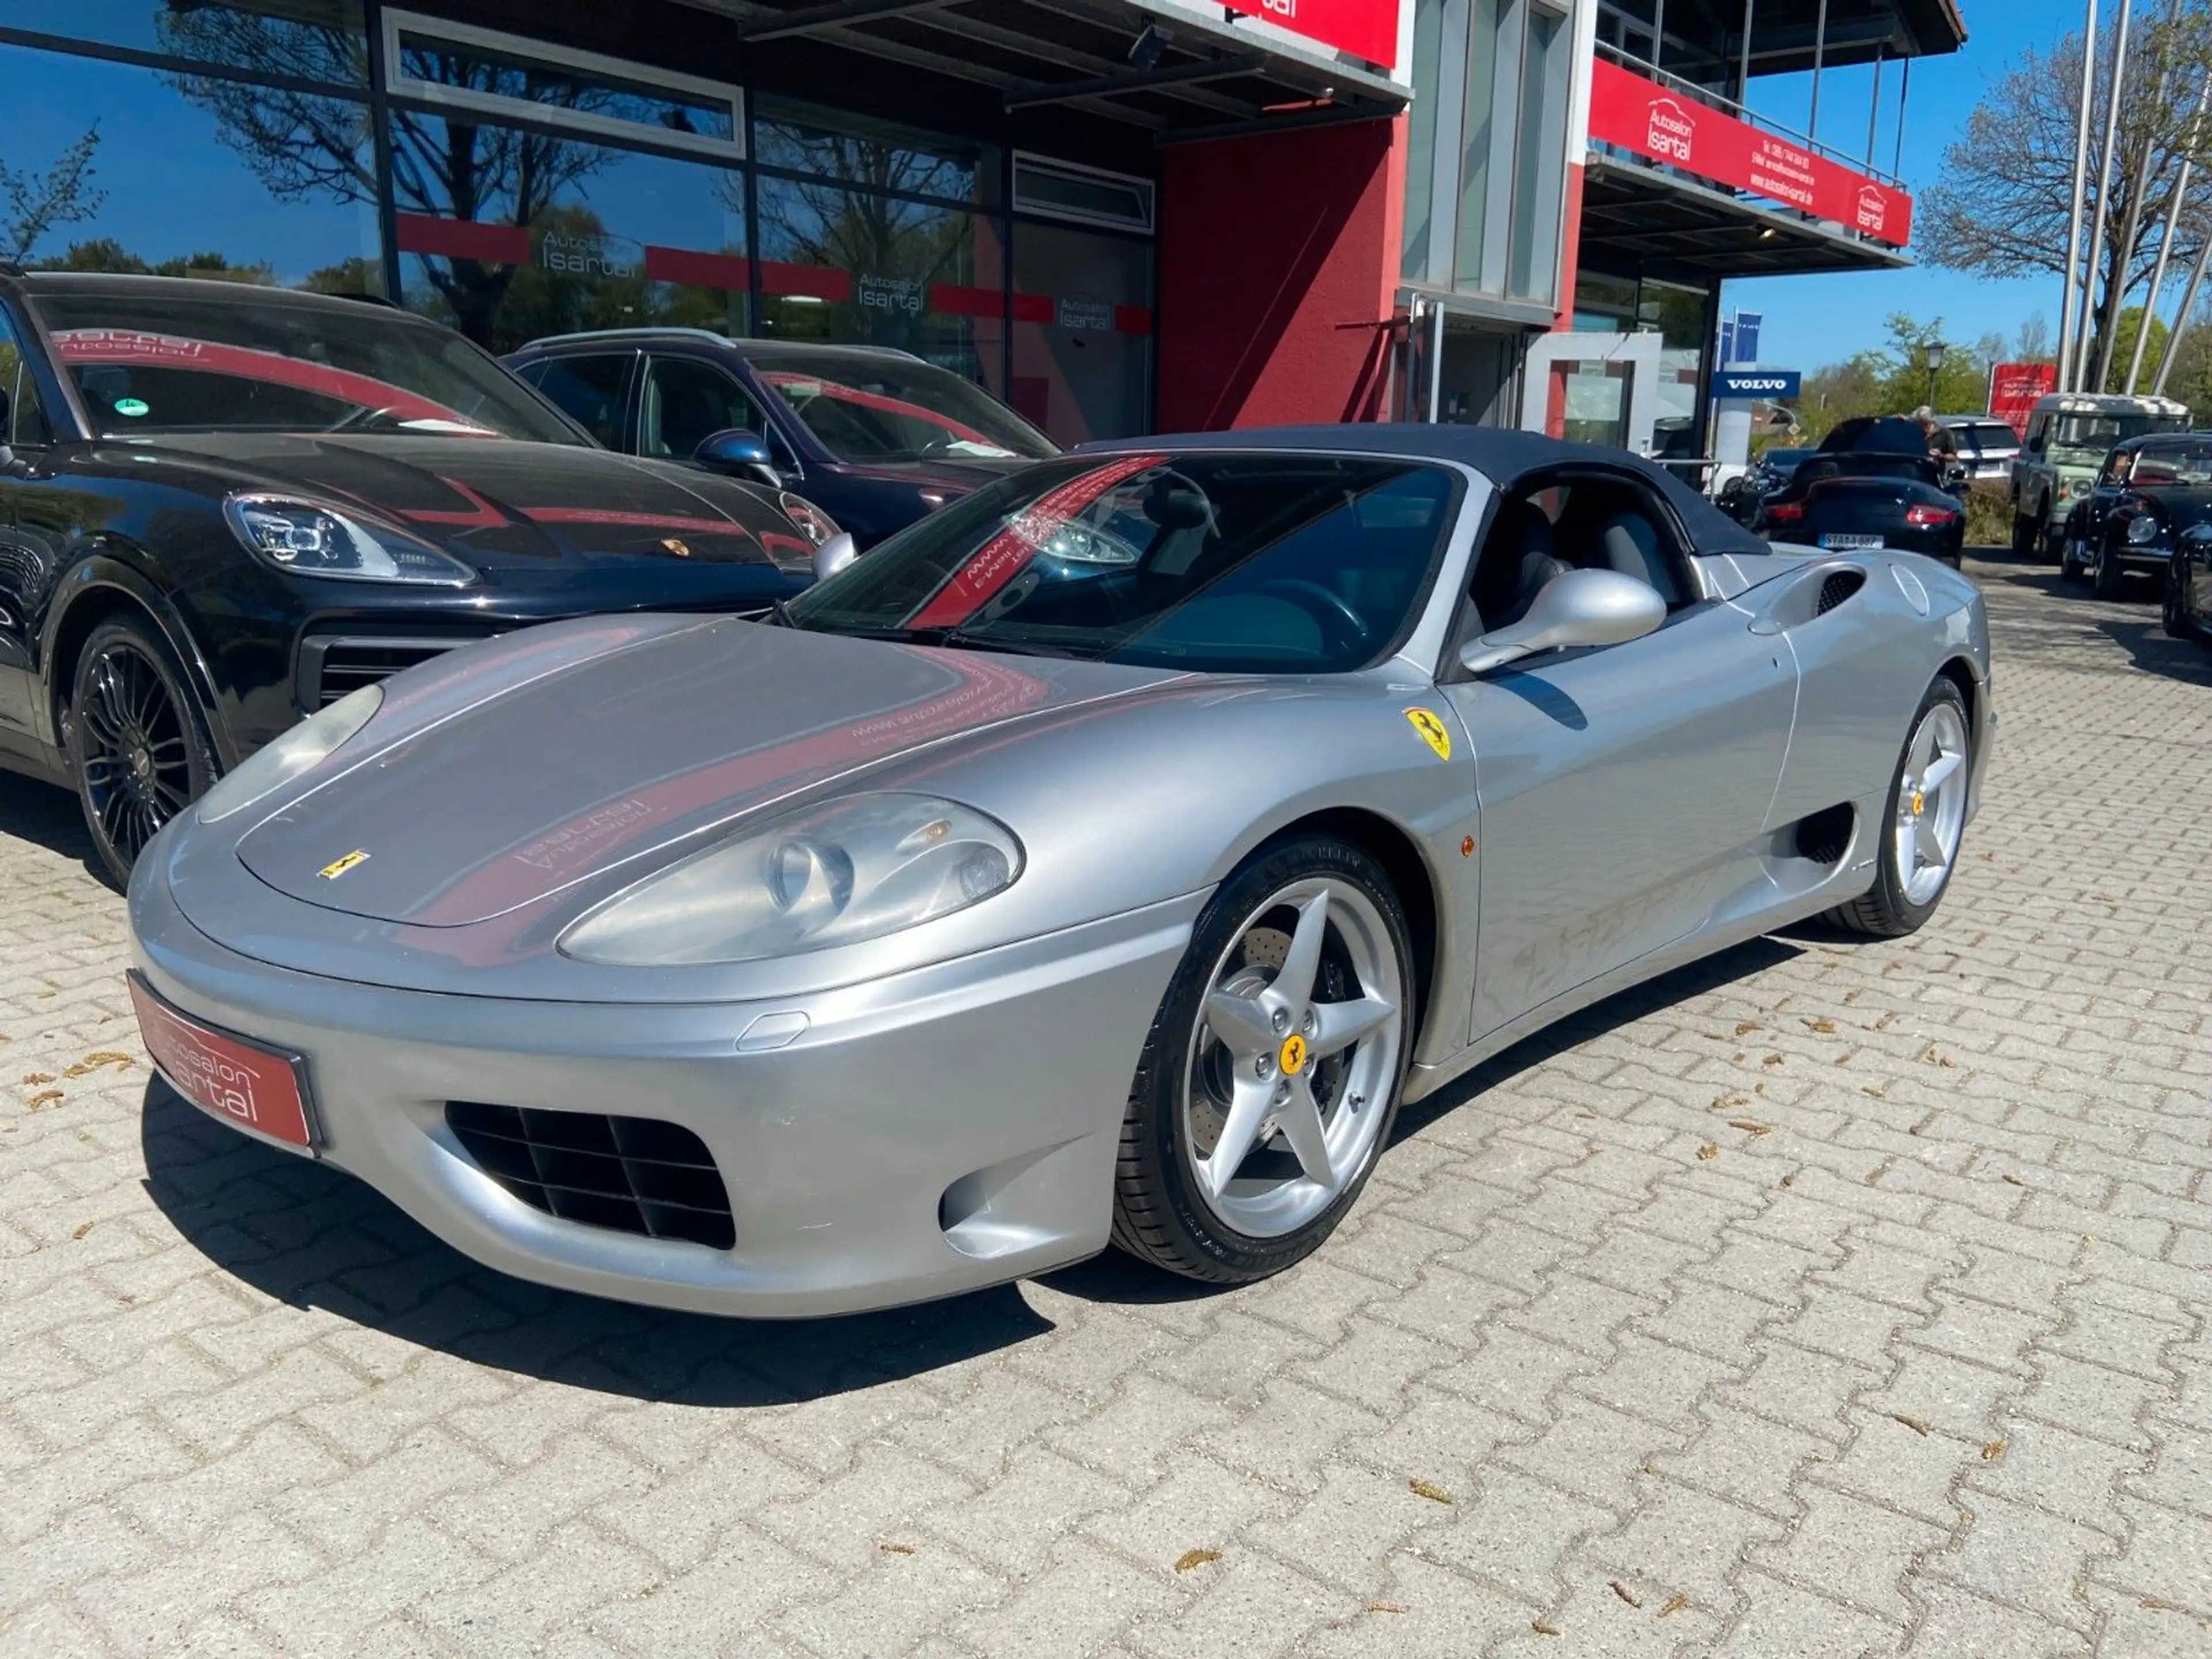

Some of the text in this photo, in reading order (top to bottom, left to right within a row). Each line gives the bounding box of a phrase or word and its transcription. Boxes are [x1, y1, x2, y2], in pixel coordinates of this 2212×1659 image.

[1647, 123, 1692, 161] Isartal
[858, 285, 923, 312] Isartal
[1726, 379, 1787, 389] VOLVO
